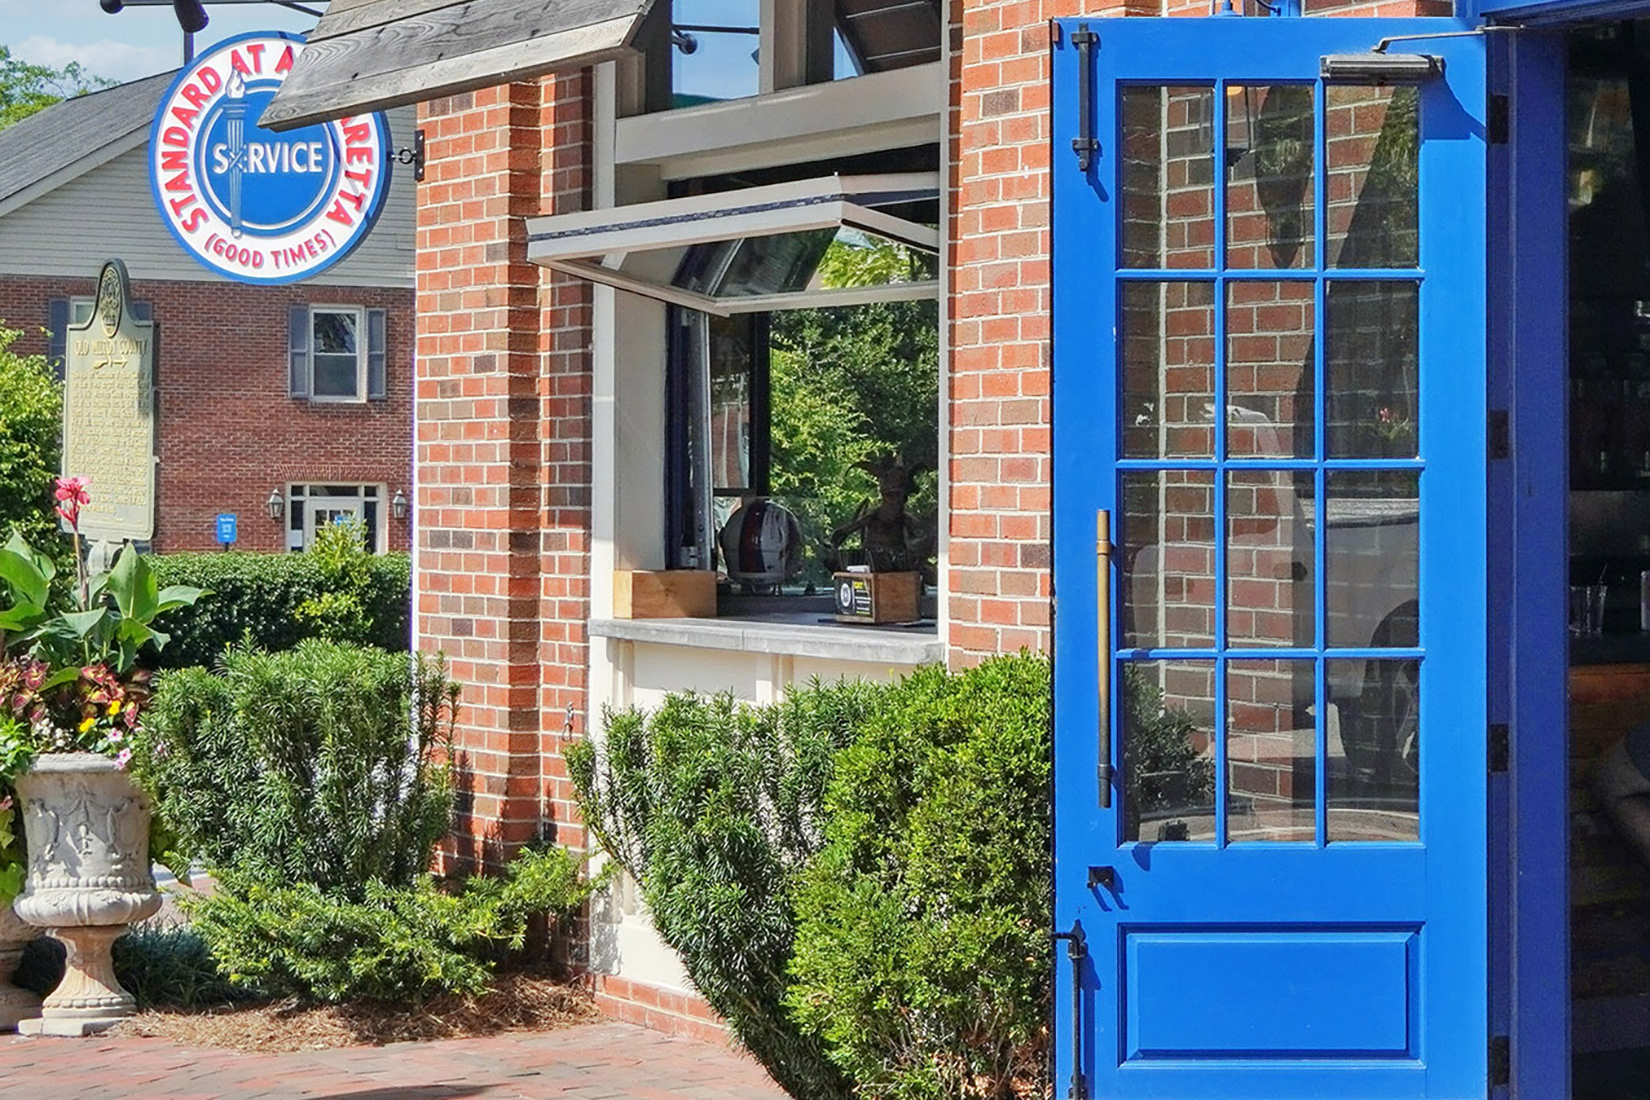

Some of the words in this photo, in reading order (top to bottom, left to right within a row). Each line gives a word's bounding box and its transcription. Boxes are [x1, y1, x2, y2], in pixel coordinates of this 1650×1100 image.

[162, 66, 221, 232] STANDARD
[231, 43, 265, 76] AT
[212, 141, 324, 175] SRVICE
[203, 232, 263, 269] (GOOD
[270, 228, 336, 269] TIMES)
